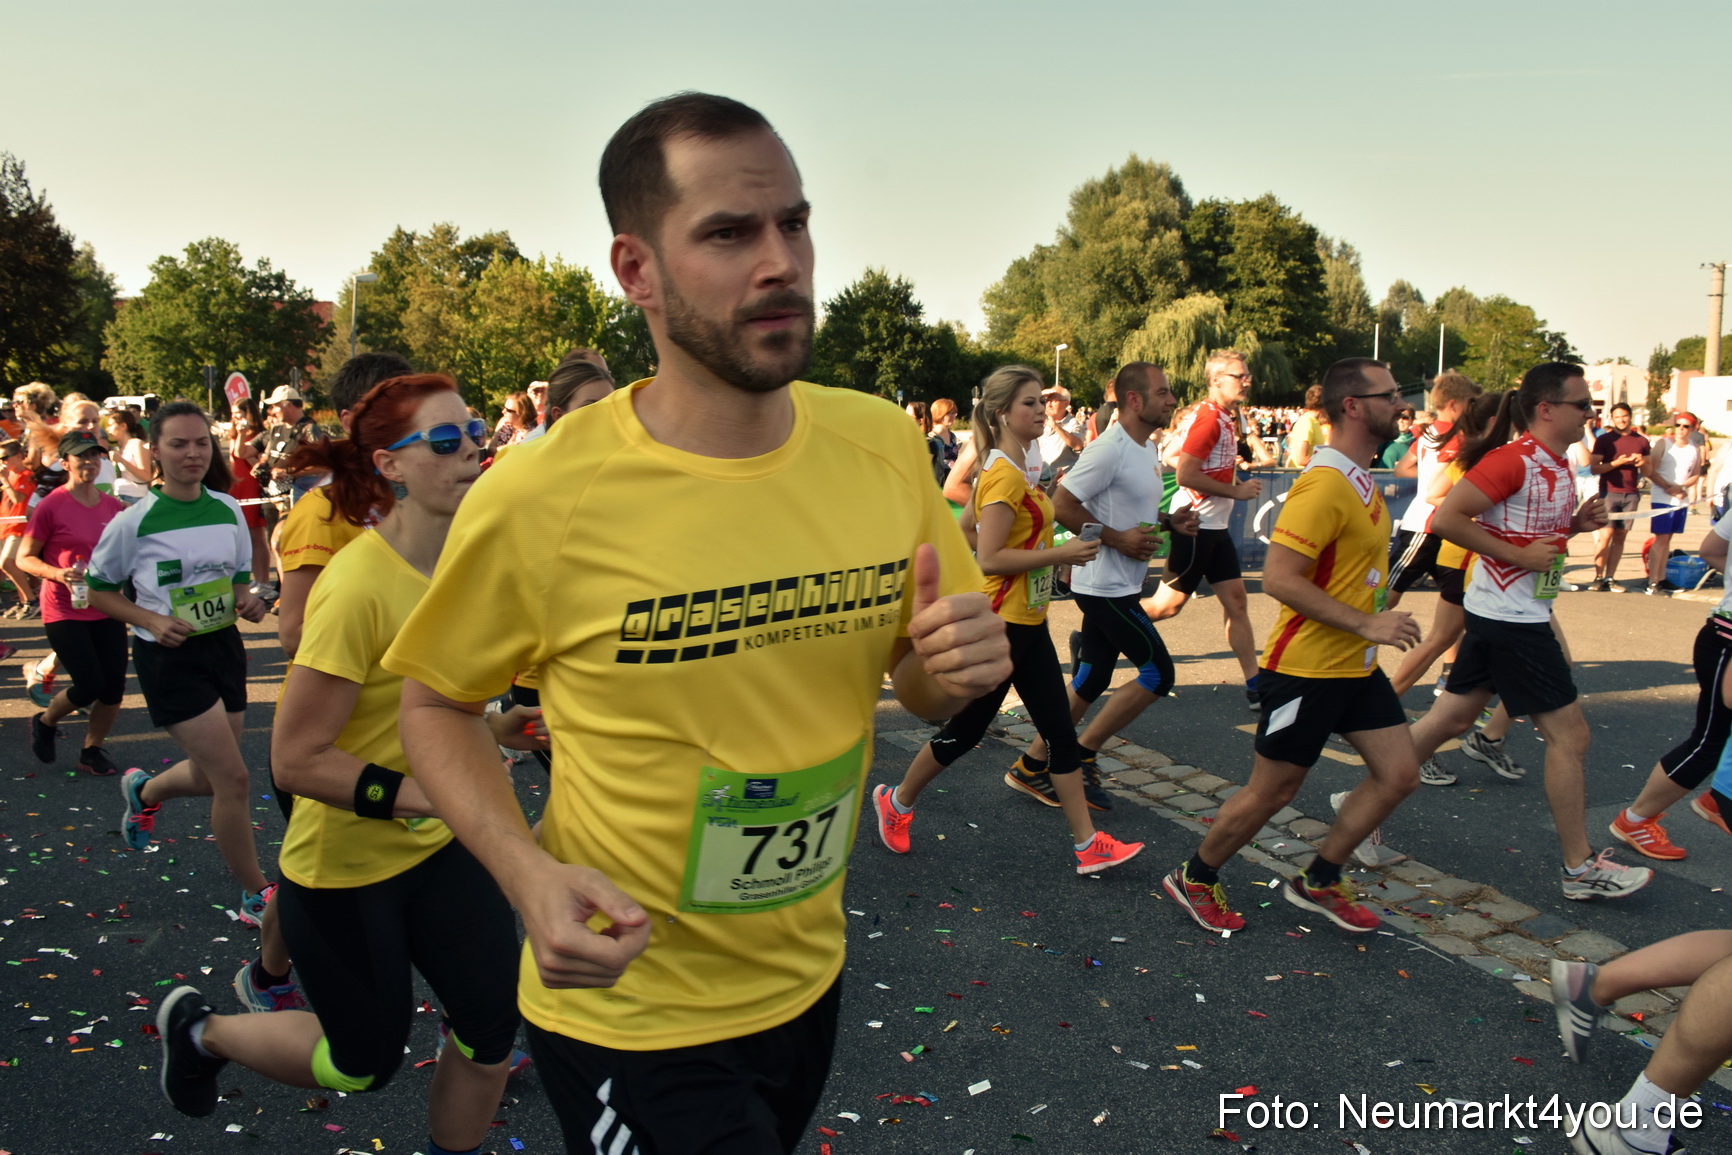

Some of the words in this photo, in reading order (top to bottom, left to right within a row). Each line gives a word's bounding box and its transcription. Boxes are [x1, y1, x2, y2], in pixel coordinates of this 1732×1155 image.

[190, 596, 226, 620] 104
[621, 558, 909, 642] grasenhiller
[743, 620, 848, 651] KOMPETENZ
[854, 616, 875, 633] IM
[741, 805, 838, 875] 737
